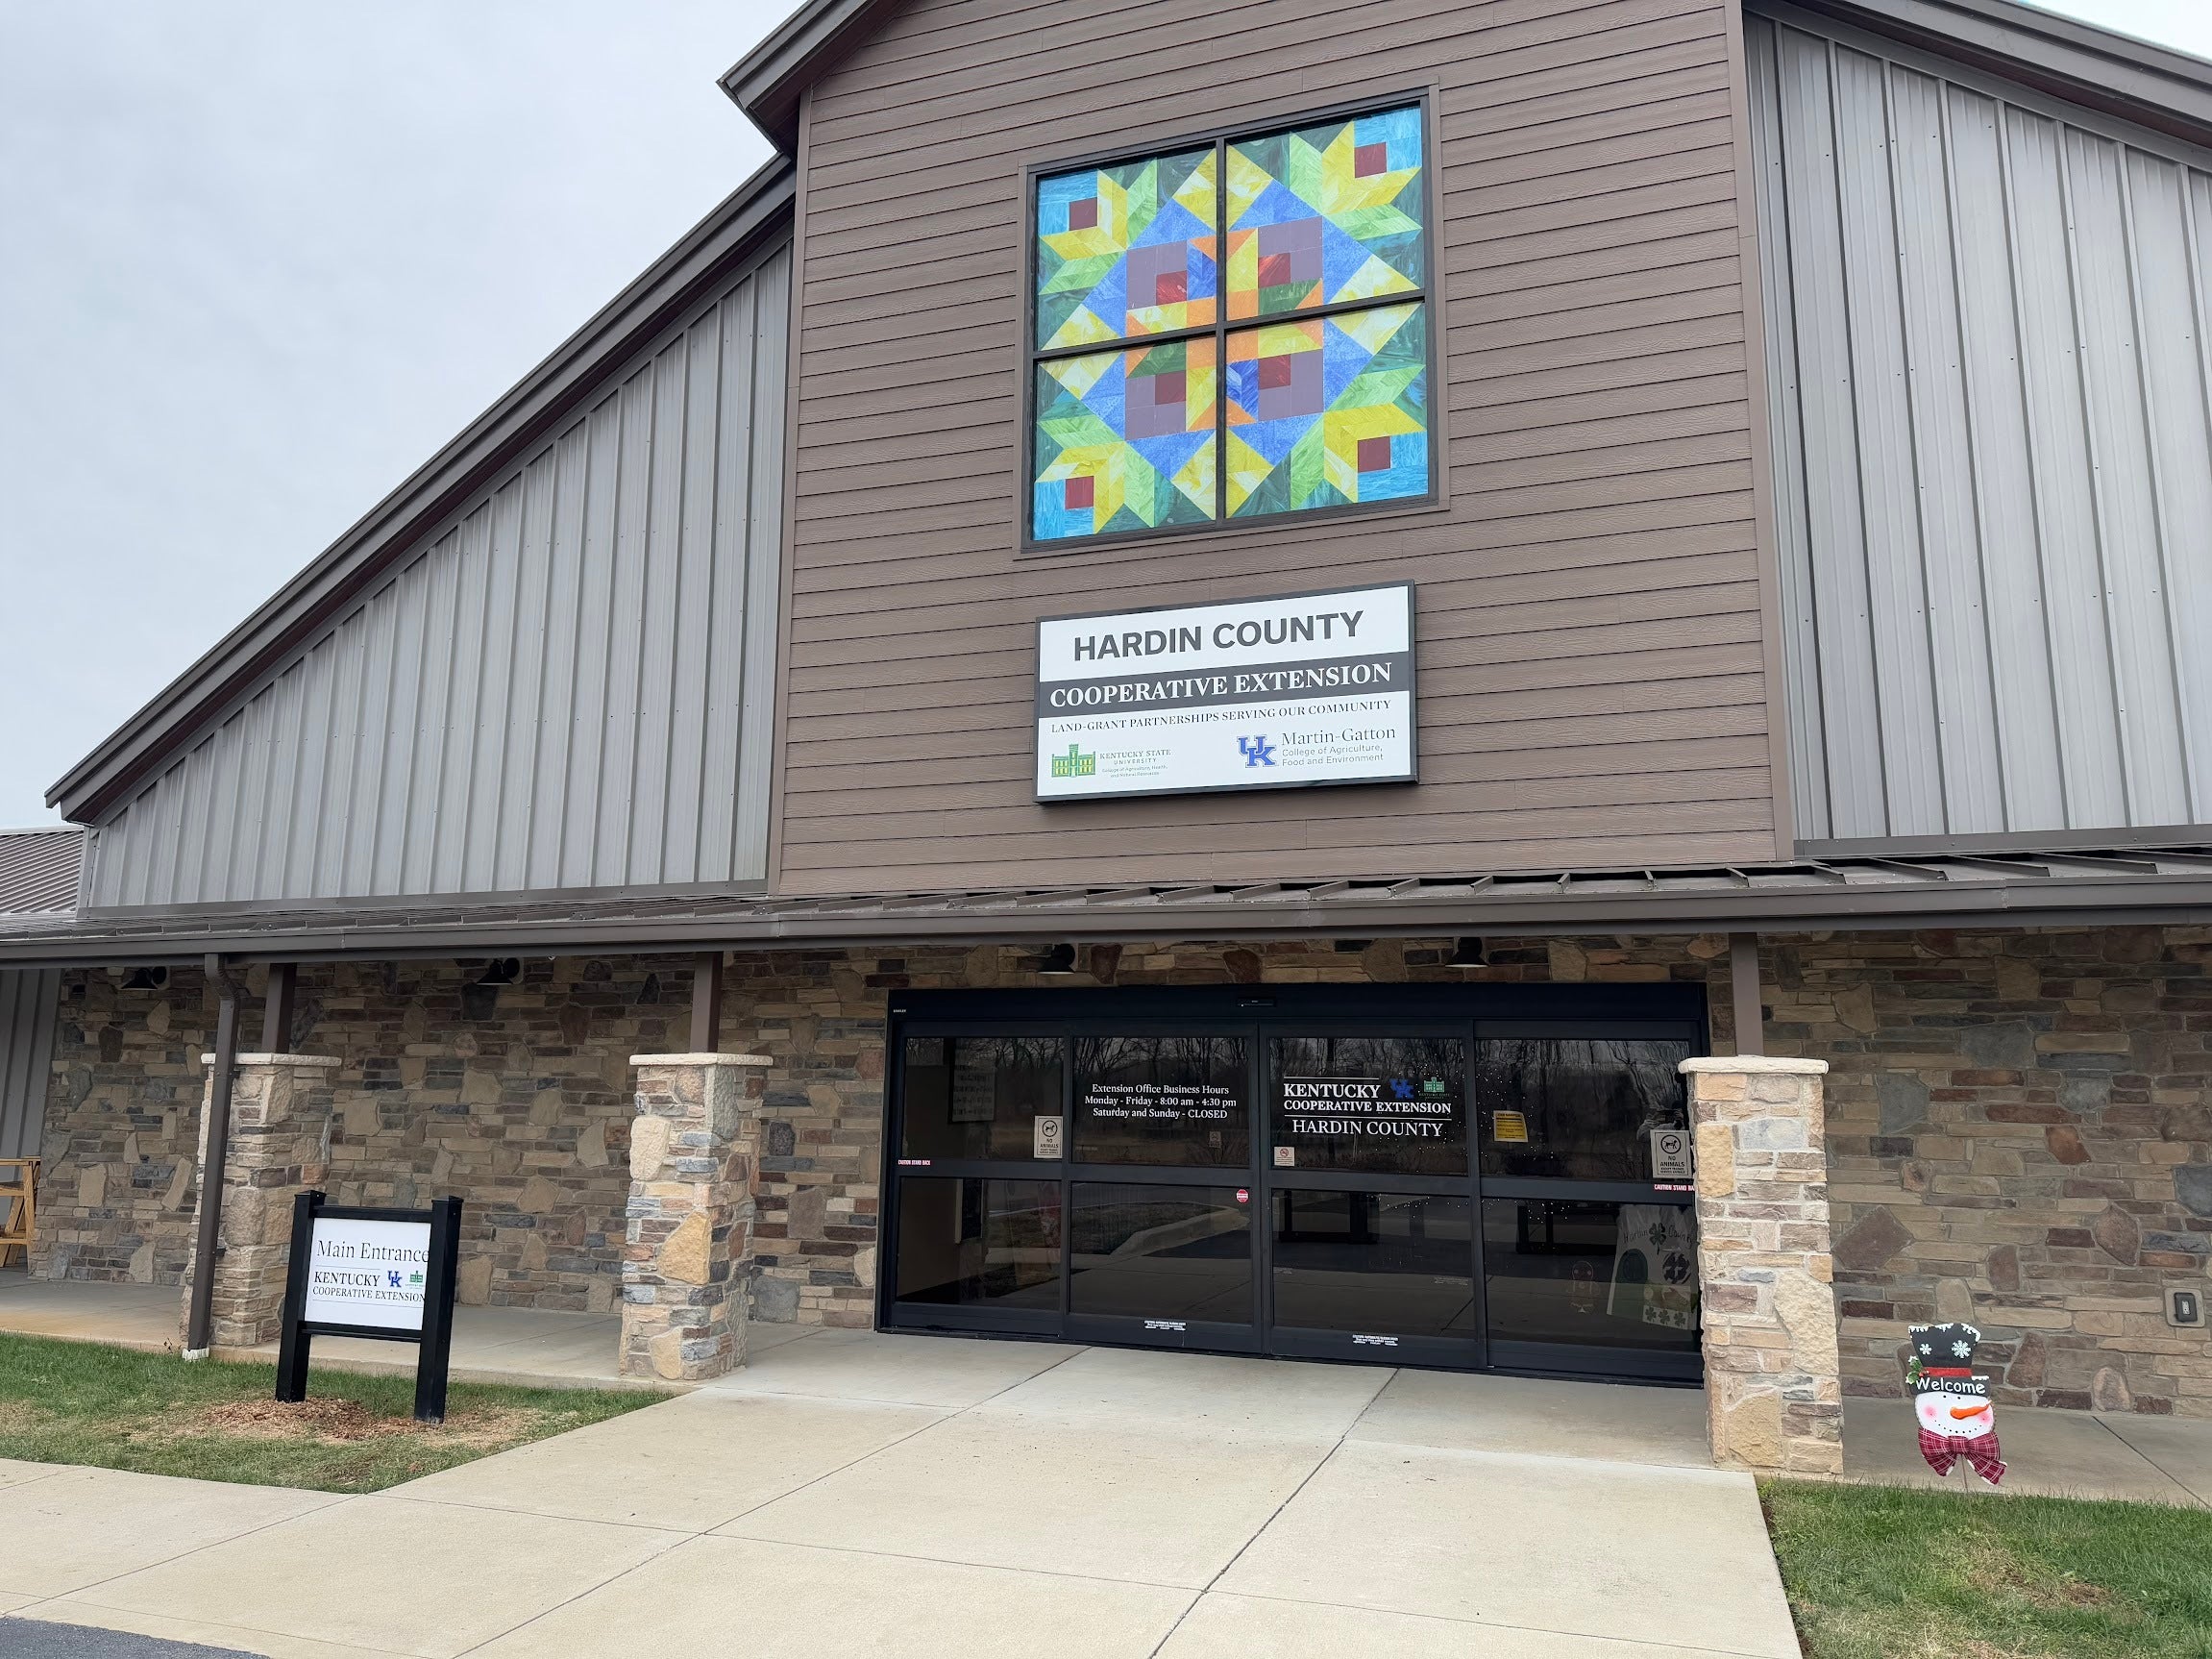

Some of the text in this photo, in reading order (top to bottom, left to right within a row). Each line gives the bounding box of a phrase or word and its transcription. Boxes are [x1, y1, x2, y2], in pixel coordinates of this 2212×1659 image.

[1073, 610, 1364, 661] HARDIN COUNTY
[1049, 662, 1392, 707] COOPERATIVE EXTENSION
[1051, 700, 1391, 733] LAND-GRANT PARTNERSHIPS SERVING OUR COMMUNITY
[1281, 727, 1396, 746] Martin-Gatton
[1099, 750, 1144, 759] KENTUCKY
[1237, 733, 1279, 769] UK
[1282, 747, 1315, 757] College
[1330, 744, 1384, 755] Agriculture,
[1282, 753, 1384, 767] Food and Environment
[1092, 1083, 1230, 1095] Extension Office Business Hours
[1283, 1083, 1381, 1099] KENTUCKY
[1084, 1095, 1118, 1106] Monday
[1125, 1096, 1153, 1107] Friday
[1160, 1097, 1179, 1106] 8:00
[1201, 1098, 1220, 1107] 4:30
[1221, 1100, 1237, 1109] pm
[1284, 1100, 1452, 1114] COOPERATIVE EXTENSION
[1093, 1107, 1130, 1119] Saturday
[1131, 1108, 1147, 1117] and
[1148, 1108, 1181, 1120] Sunday
[1188, 1109, 1228, 1119] CLOSED
[1291, 1119, 1443, 1137] HARDIN COUNTY
[316, 1240, 430, 1263] Main Entrance
[313, 1271, 381, 1287] KENTUCKY
[387, 1270, 403, 1288] UK
[312, 1286, 426, 1302] COOPERATIVE EXTENSION
[1915, 1377, 1986, 1394] Welcome
